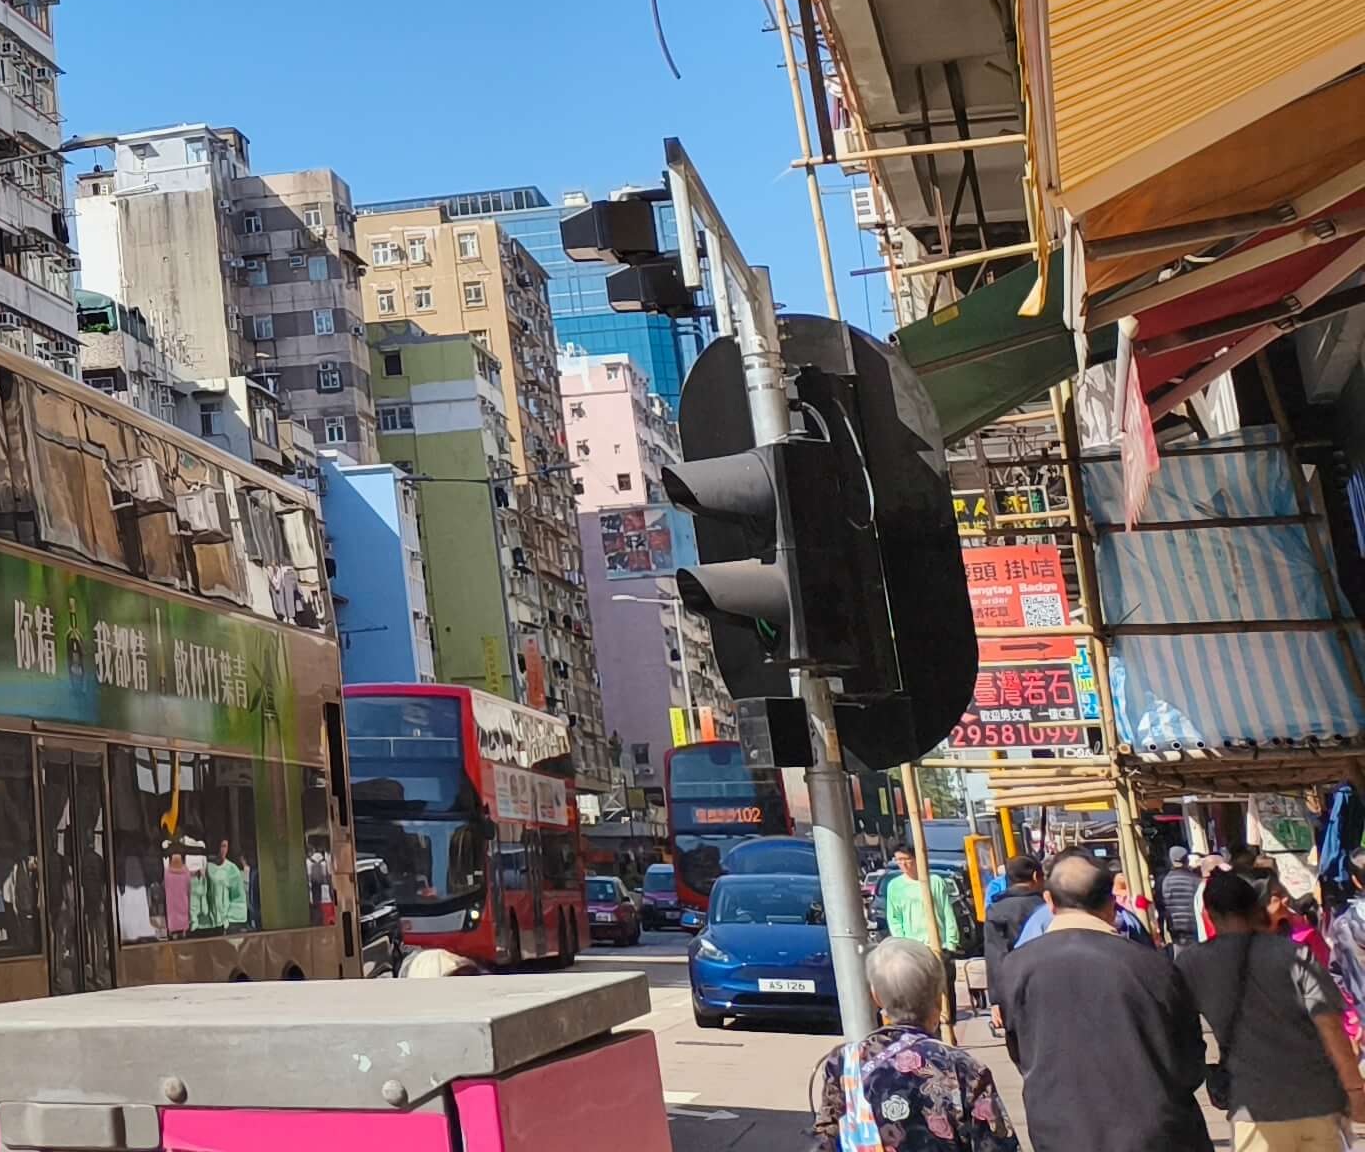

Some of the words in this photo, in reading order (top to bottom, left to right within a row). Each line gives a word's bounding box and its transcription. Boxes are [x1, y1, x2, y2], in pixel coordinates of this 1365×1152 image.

[1019, 582, 1058, 593] Badge
[93, 620, 149, 692] 我都精
[950, 723, 1079, 746] 29581099
[734, 806, 763, 823] 102
